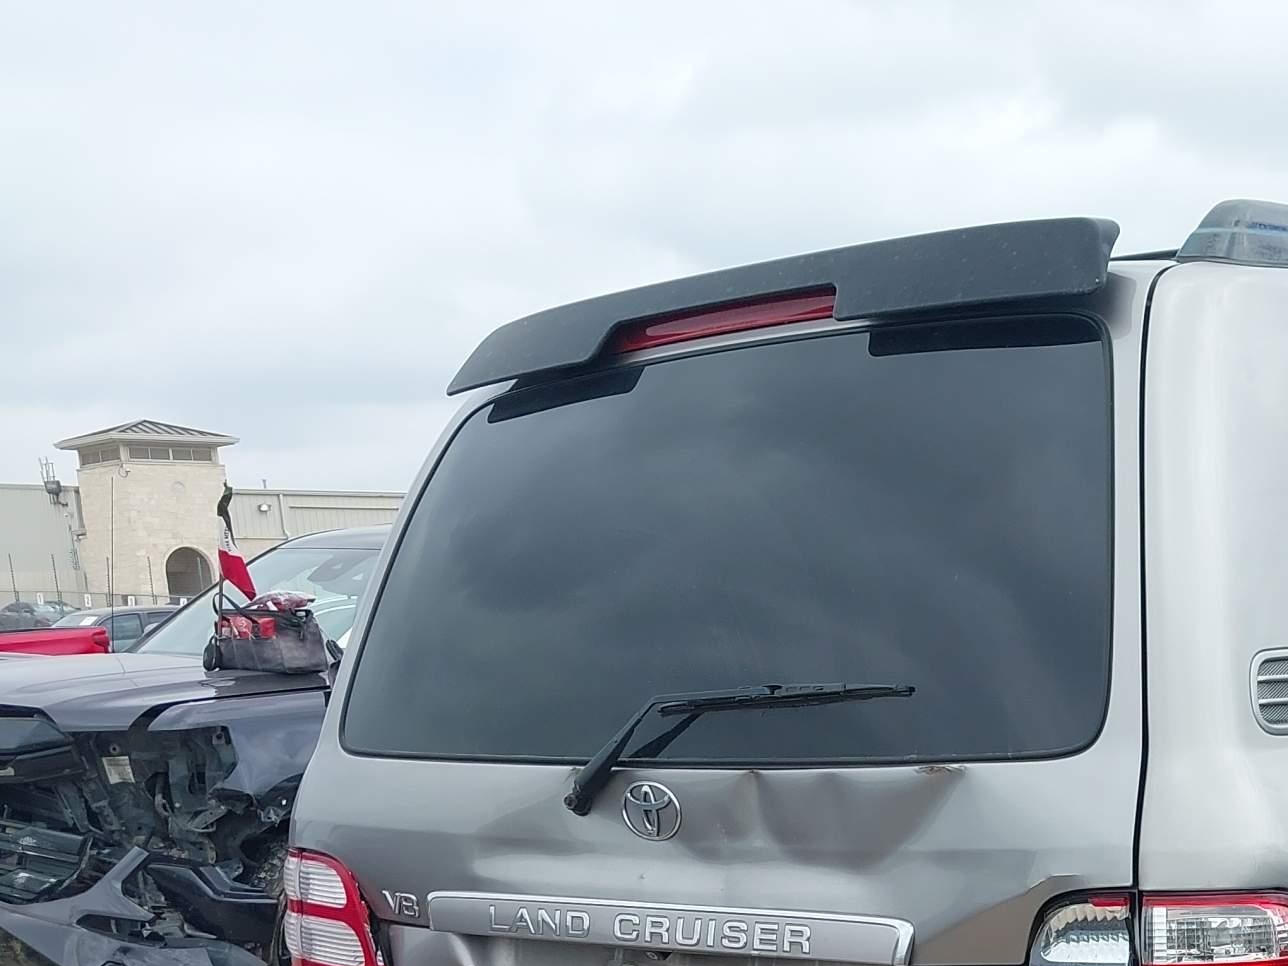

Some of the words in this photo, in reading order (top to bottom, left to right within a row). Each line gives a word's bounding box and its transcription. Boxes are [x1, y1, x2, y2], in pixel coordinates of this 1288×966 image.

[382, 890, 420, 917] V8
[487, 903, 592, 937] LAND
[612, 916, 813, 956] CRUISER
